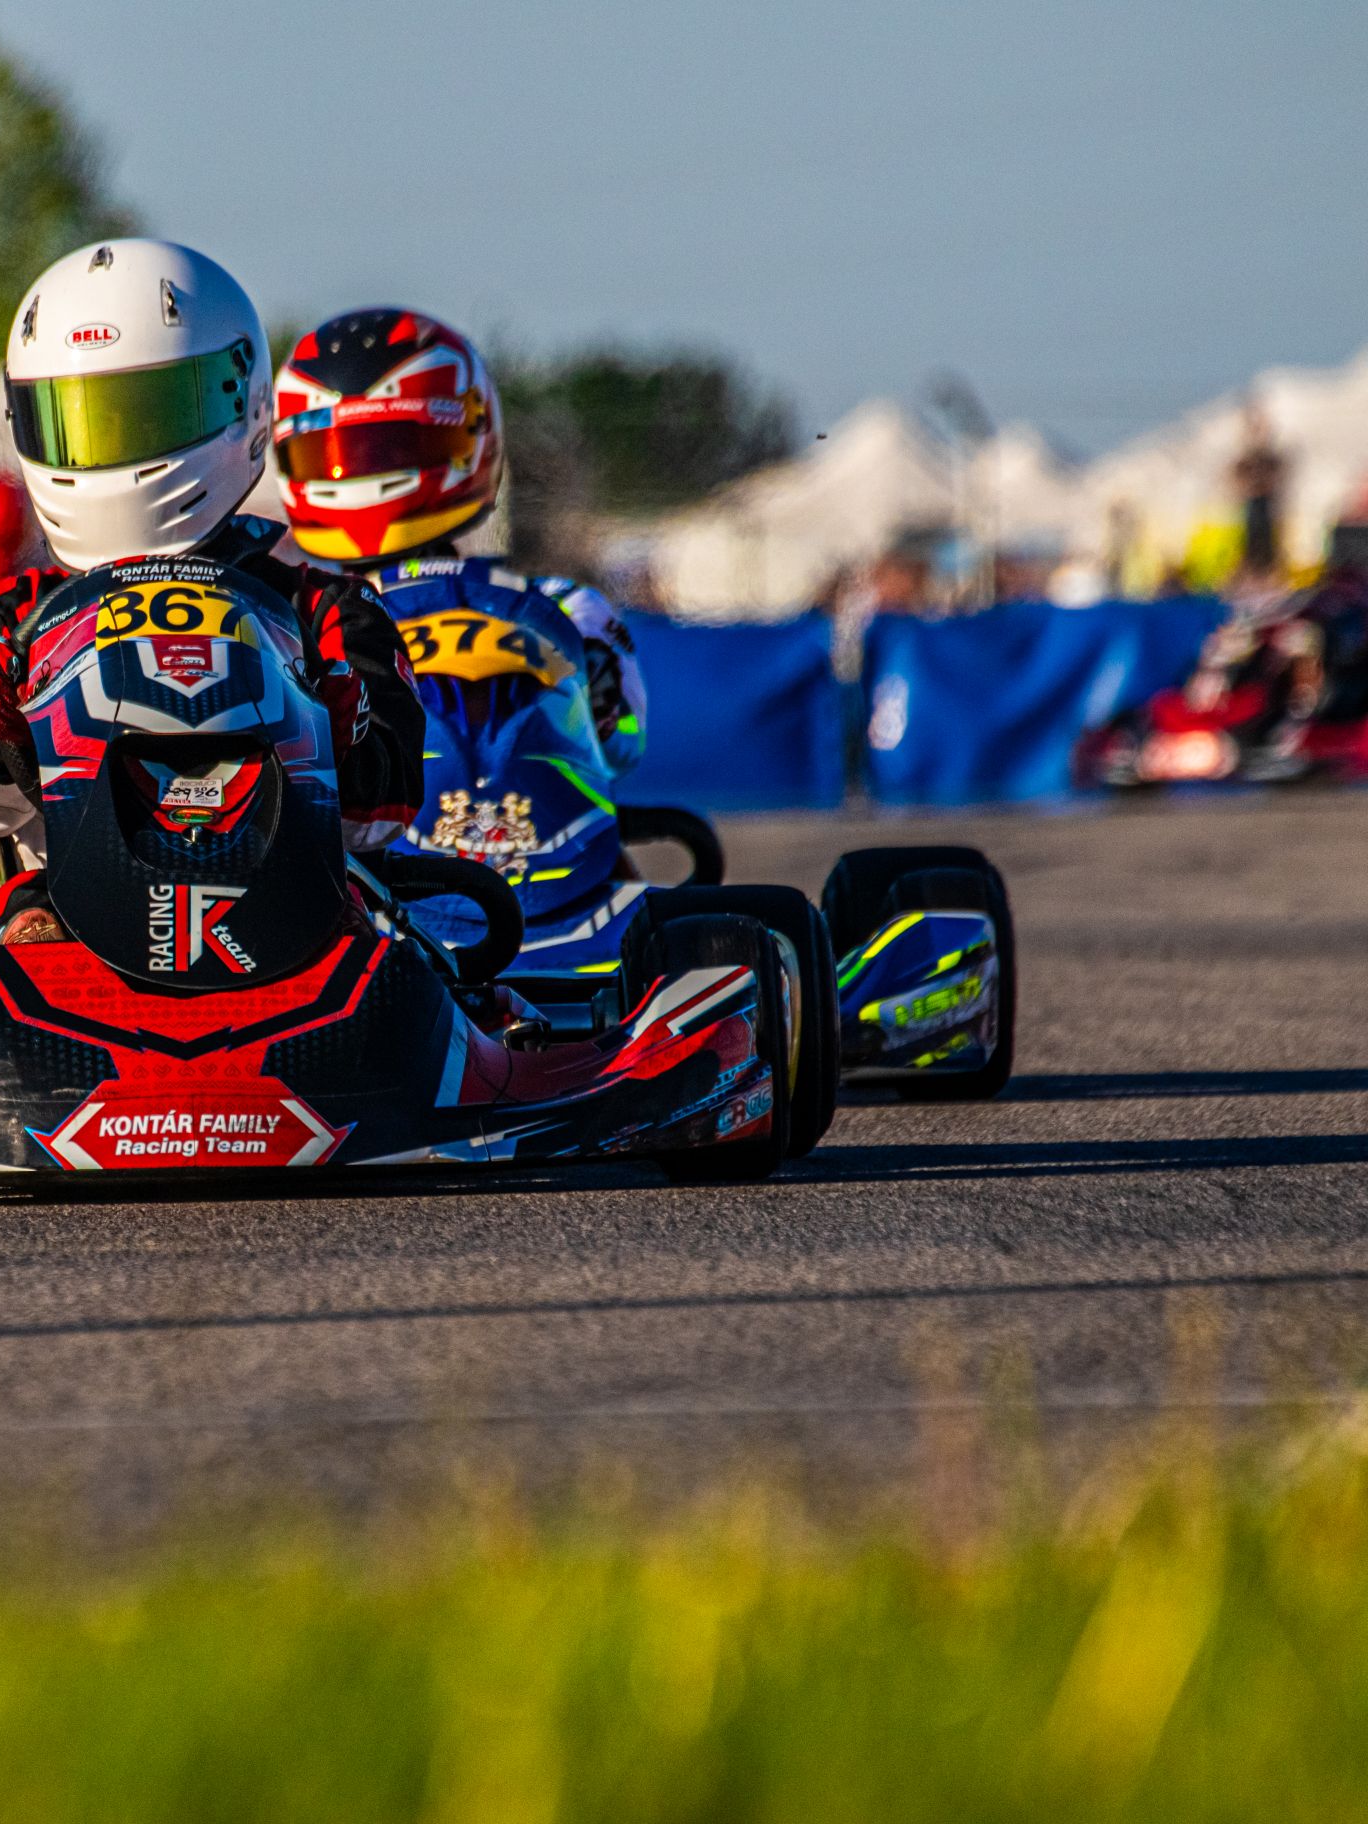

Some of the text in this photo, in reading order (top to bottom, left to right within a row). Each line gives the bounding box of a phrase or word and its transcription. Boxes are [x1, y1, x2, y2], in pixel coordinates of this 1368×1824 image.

[72, 328, 113, 343] BELL
[111, 563, 224, 579] KONTÁR FAMILY
[122, 573, 215, 583] Racing Team
[96, 587, 241, 639] 367
[149, 884, 174, 972] RACING
[211, 924, 257, 973] team
[99, 1110, 281, 1138] KONTÁR FAMILY
[115, 1136, 267, 1157] Racing Team
